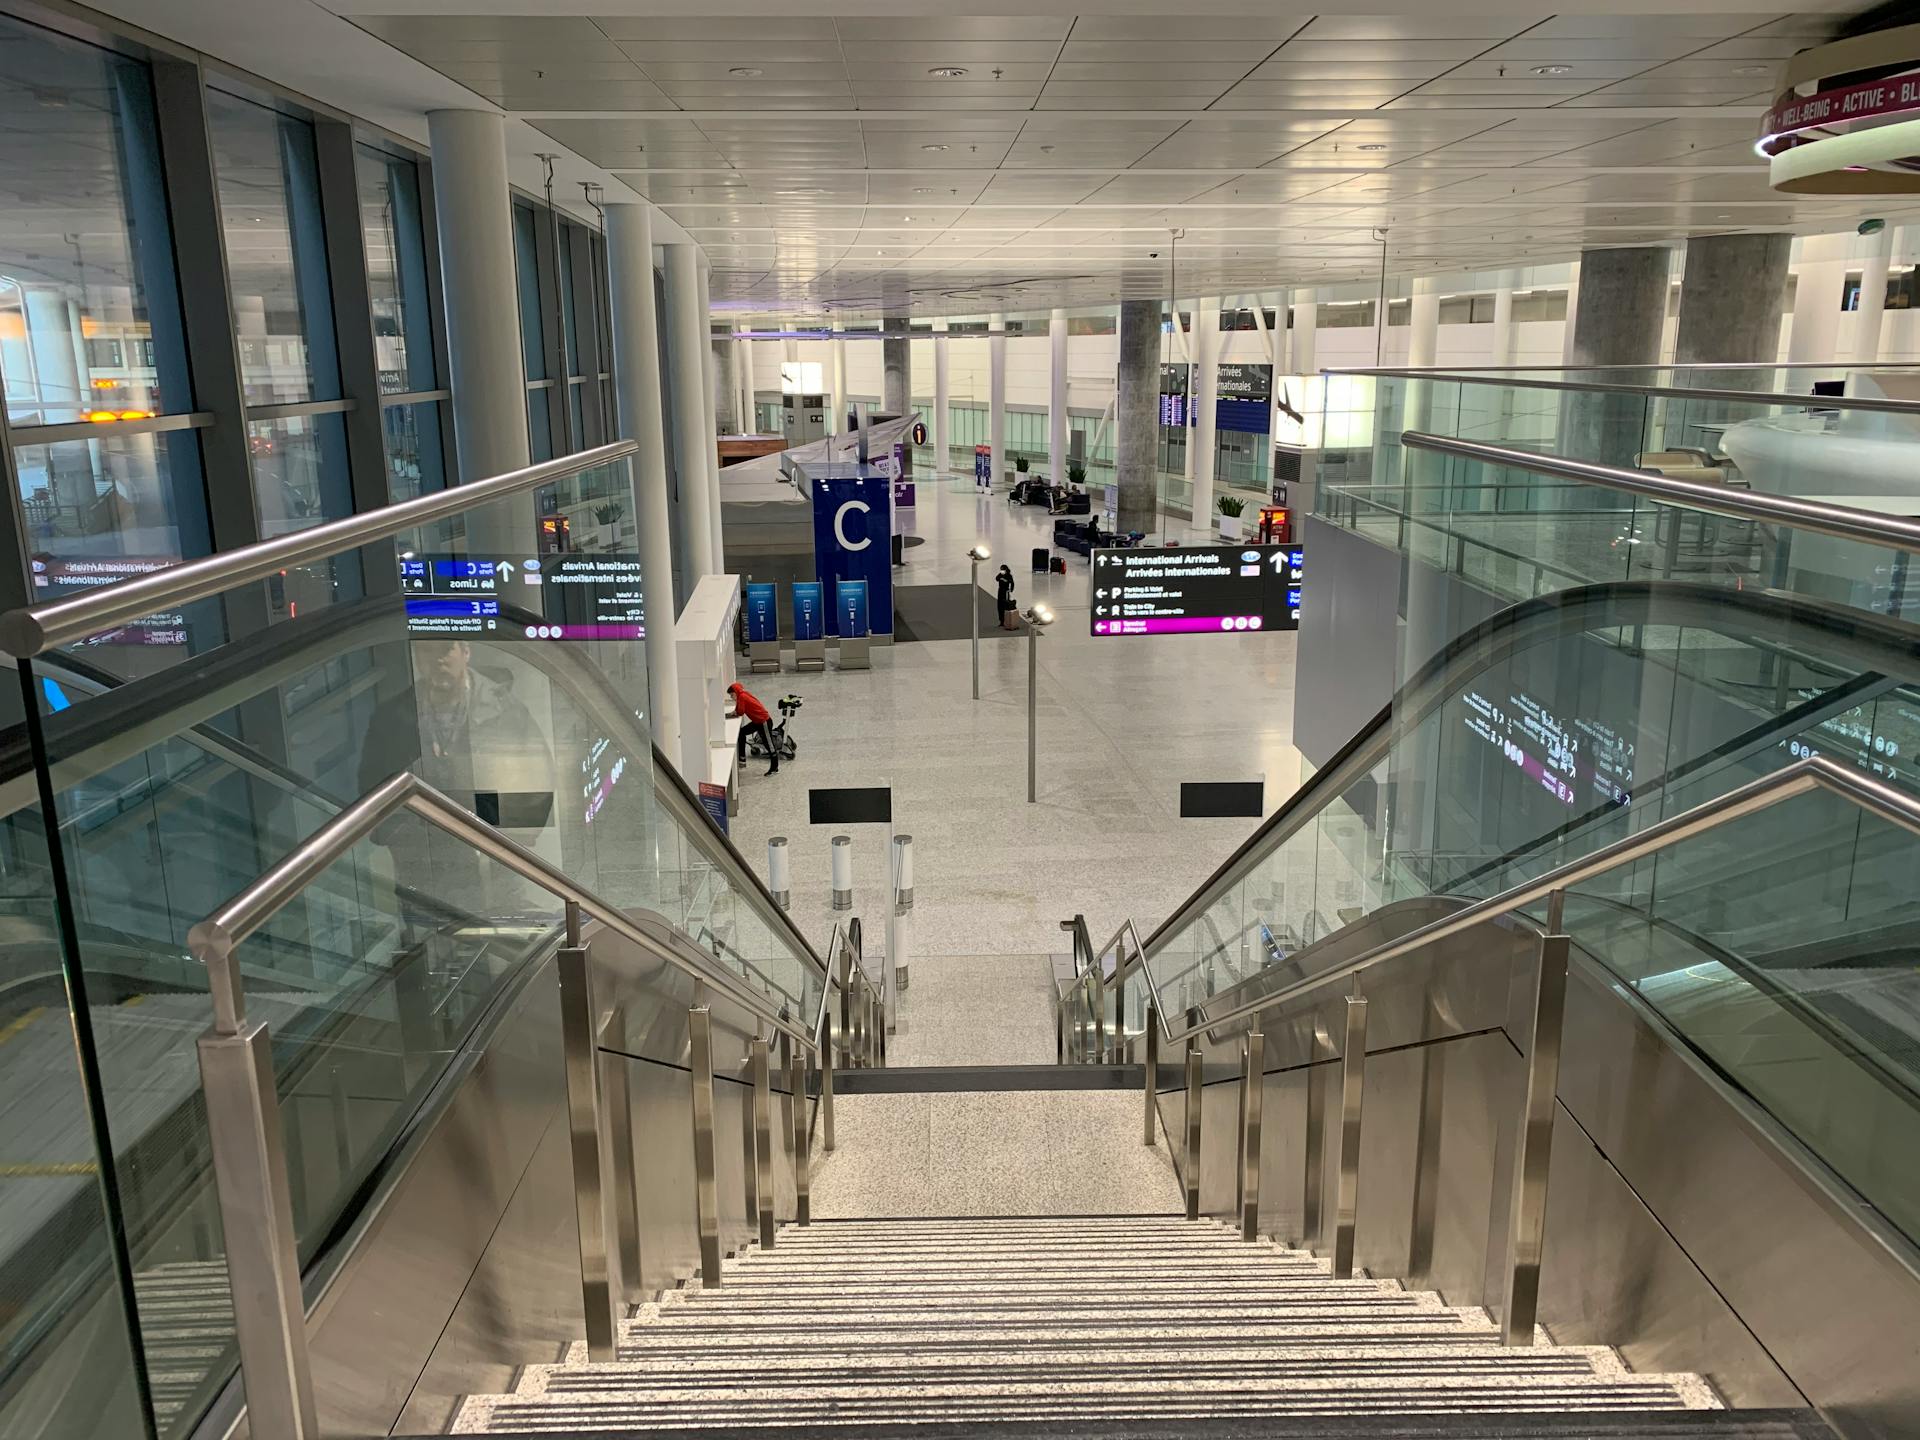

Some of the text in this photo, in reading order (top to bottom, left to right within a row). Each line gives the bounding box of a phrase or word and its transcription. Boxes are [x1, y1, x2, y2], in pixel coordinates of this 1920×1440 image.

[1782, 98, 1831, 127] WELL-BEING
[1842, 87, 1885, 113] ACTIVE
[1900, 81, 1920, 103] BL
[833, 499, 873, 552] C
[1125, 566, 1231, 578] Arrivées internationales
[1126, 554, 1219, 566] International Arrivals
